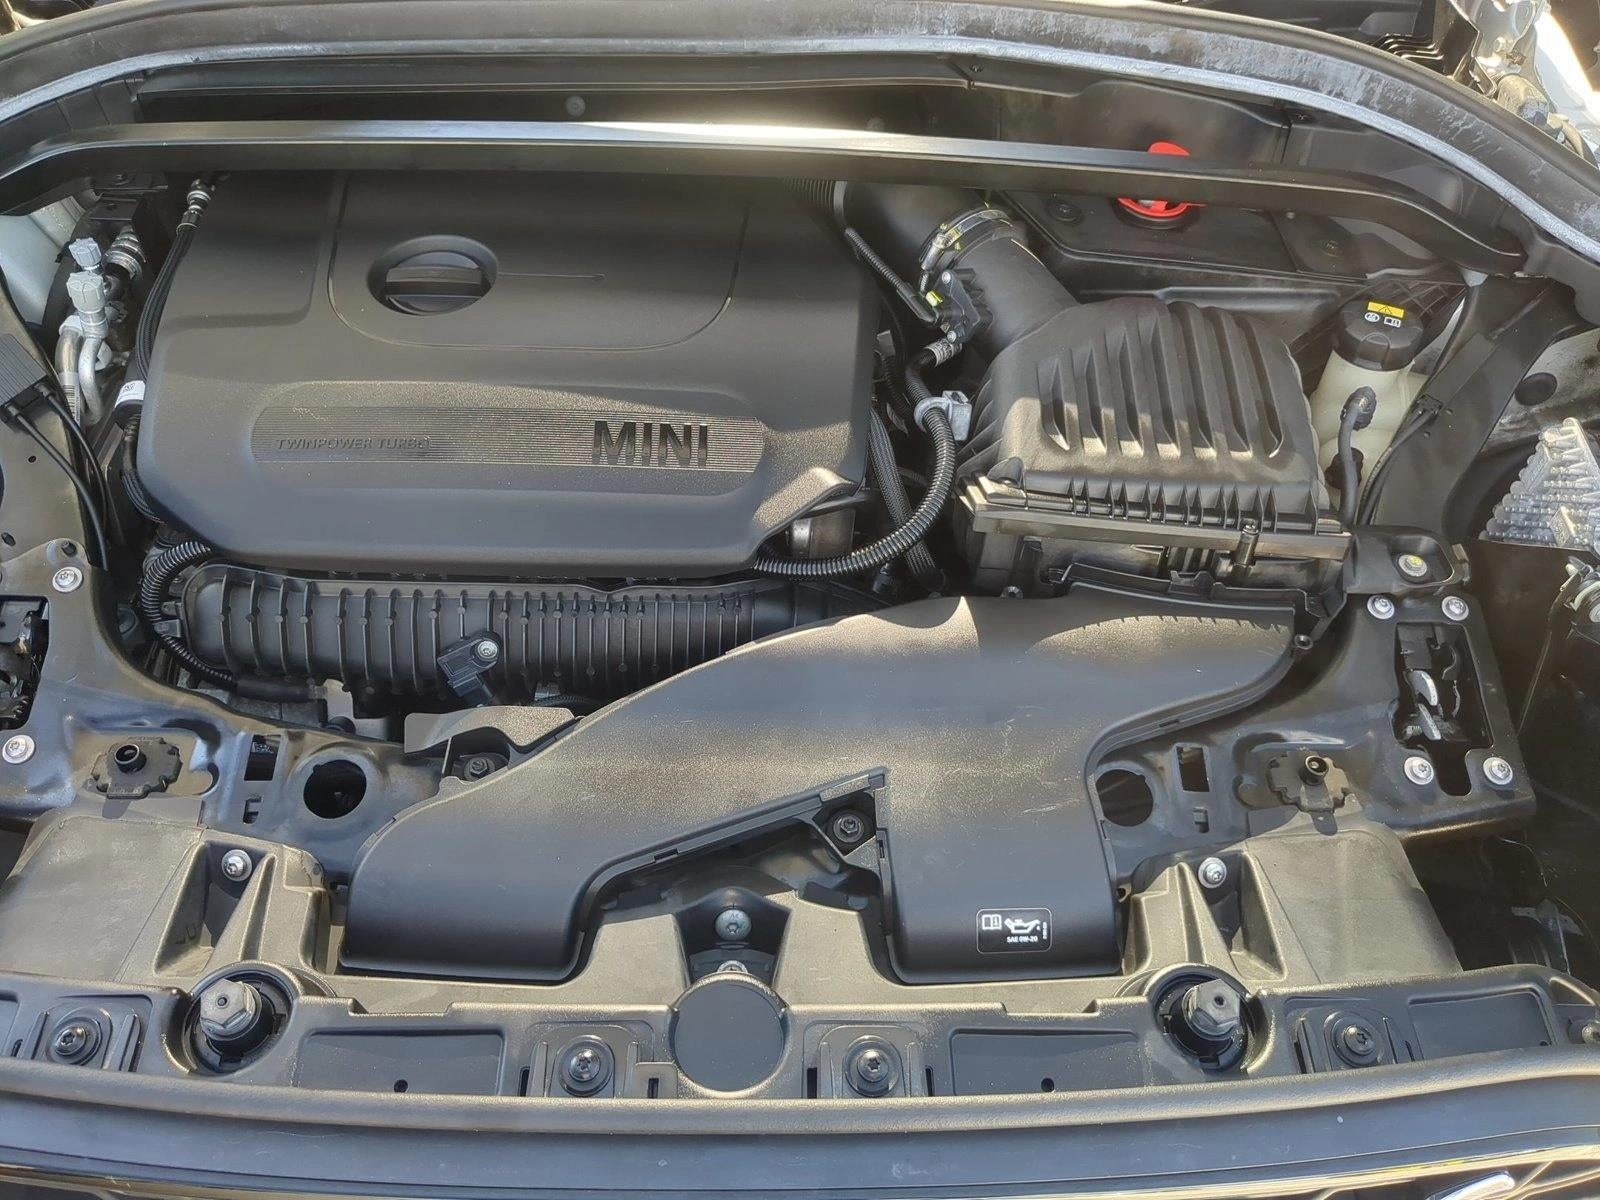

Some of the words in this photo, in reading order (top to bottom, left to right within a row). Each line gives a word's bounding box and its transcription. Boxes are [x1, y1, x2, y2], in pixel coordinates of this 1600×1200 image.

[276, 437, 373, 450] TWINPOWER
[378, 437, 431, 451] TURBO
[592, 420, 708, 466] MINI
[1006, 935, 1018, 943] SAE
